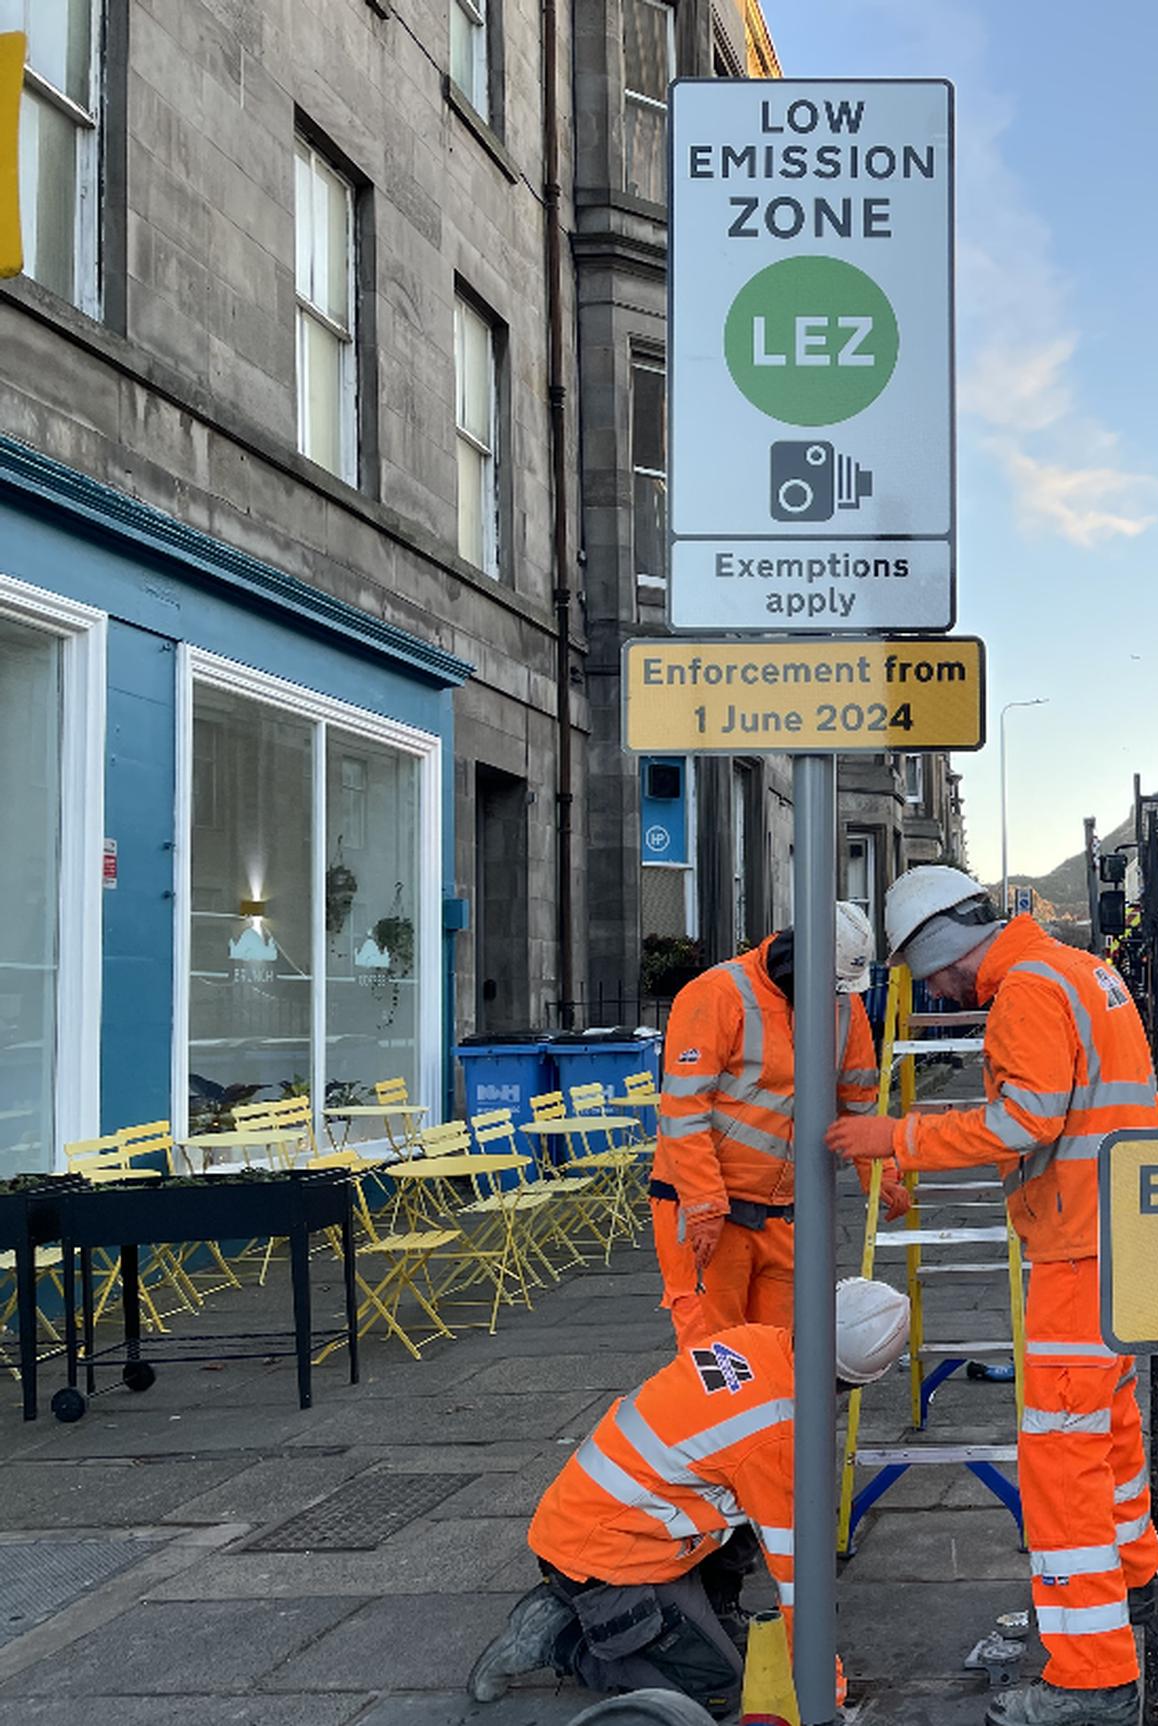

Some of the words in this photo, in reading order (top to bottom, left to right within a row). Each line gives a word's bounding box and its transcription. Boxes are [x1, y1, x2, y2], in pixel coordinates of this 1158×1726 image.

[761, 99, 865, 134] LOW
[689, 145, 935, 180] EMISSION
[728, 196, 892, 239] ZONE
[753, 316, 875, 366] LEZ
[714, 552, 909, 583] Exemptions
[766, 587, 856, 617] apply
[643, 657, 871, 686] Enforcement
[884, 655, 967, 684] from
[694, 706, 707, 734] 1
[721, 705, 803, 734] June
[816, 703, 914, 732] 2024
